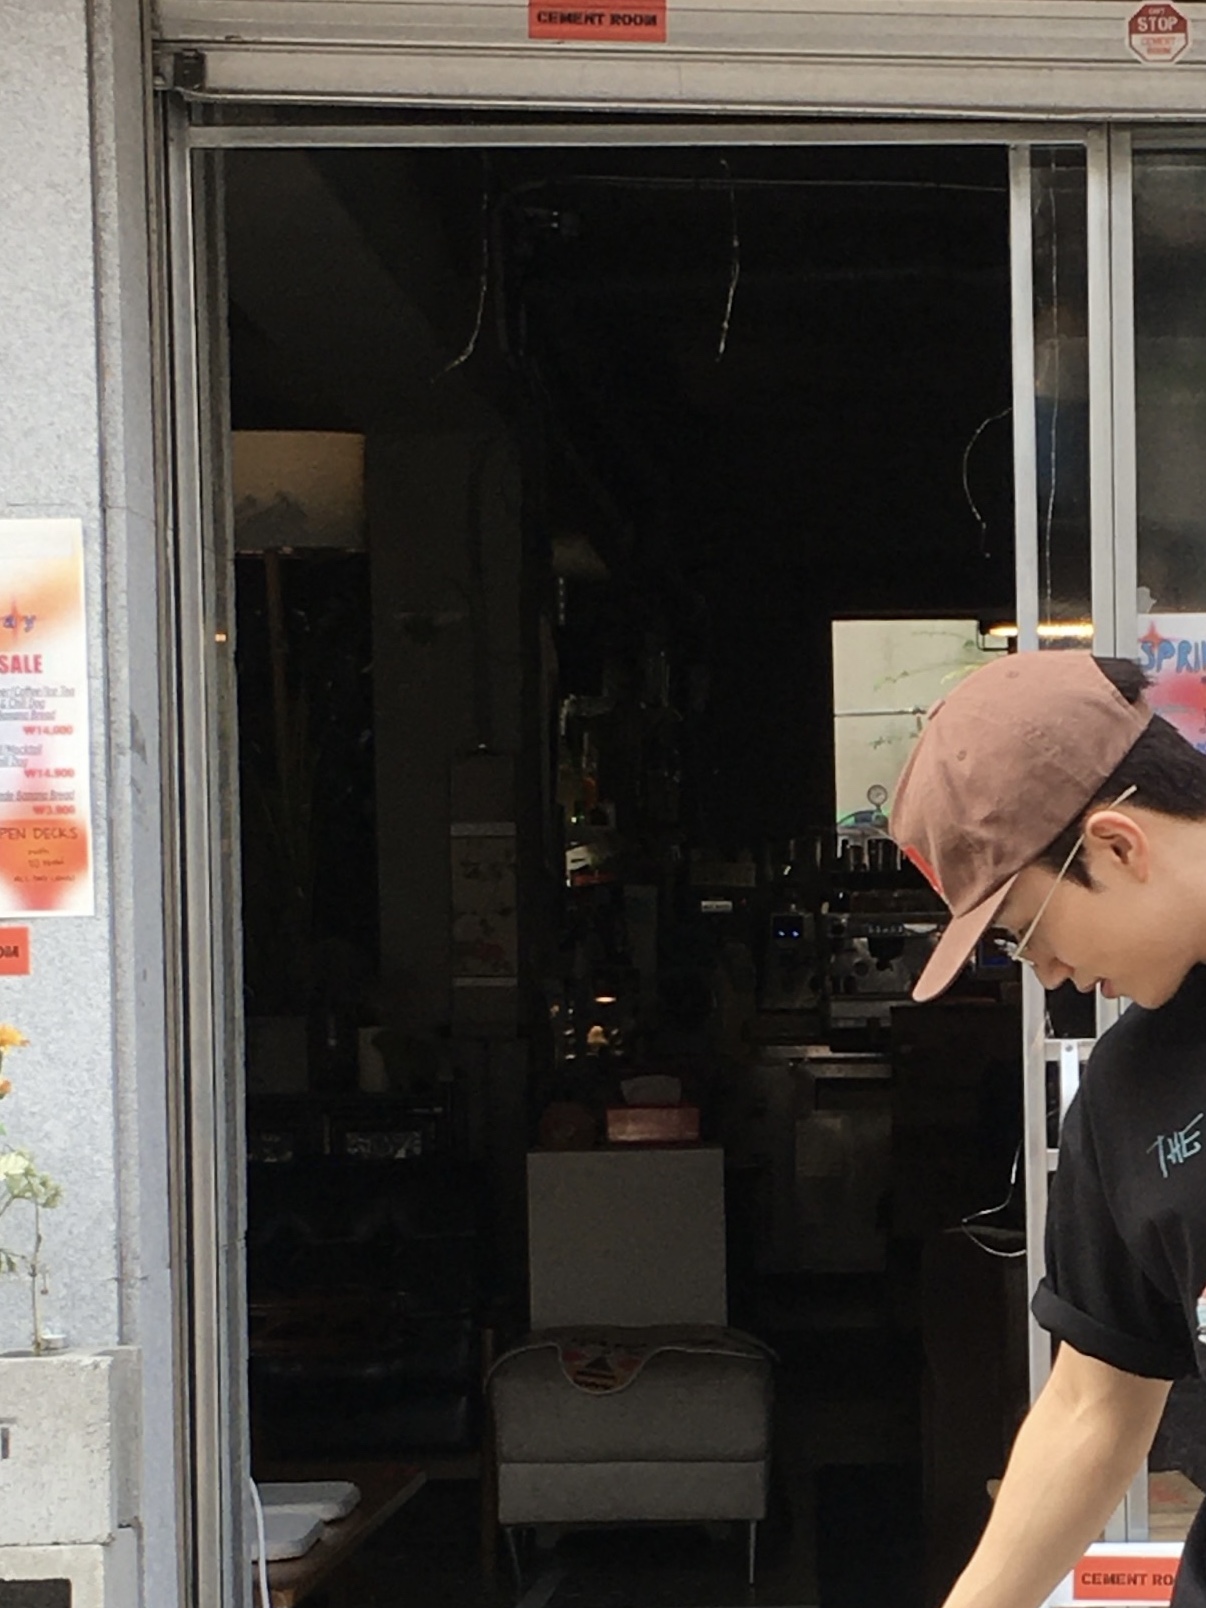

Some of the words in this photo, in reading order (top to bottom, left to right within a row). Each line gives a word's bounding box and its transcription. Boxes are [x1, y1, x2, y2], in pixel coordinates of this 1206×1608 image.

[537, 11, 604, 25] CEMENT
[610, 13, 657, 26] ROOM
[1137, 16, 1178, 32] STOP
[0, 654, 43, 674] SALE
[33, 827, 78, 840] DECKS
[1148, 1113, 1204, 1178] THE
[1081, 1572, 1148, 1586] CEMENT
[1152, 1573, 1175, 1587] RO
